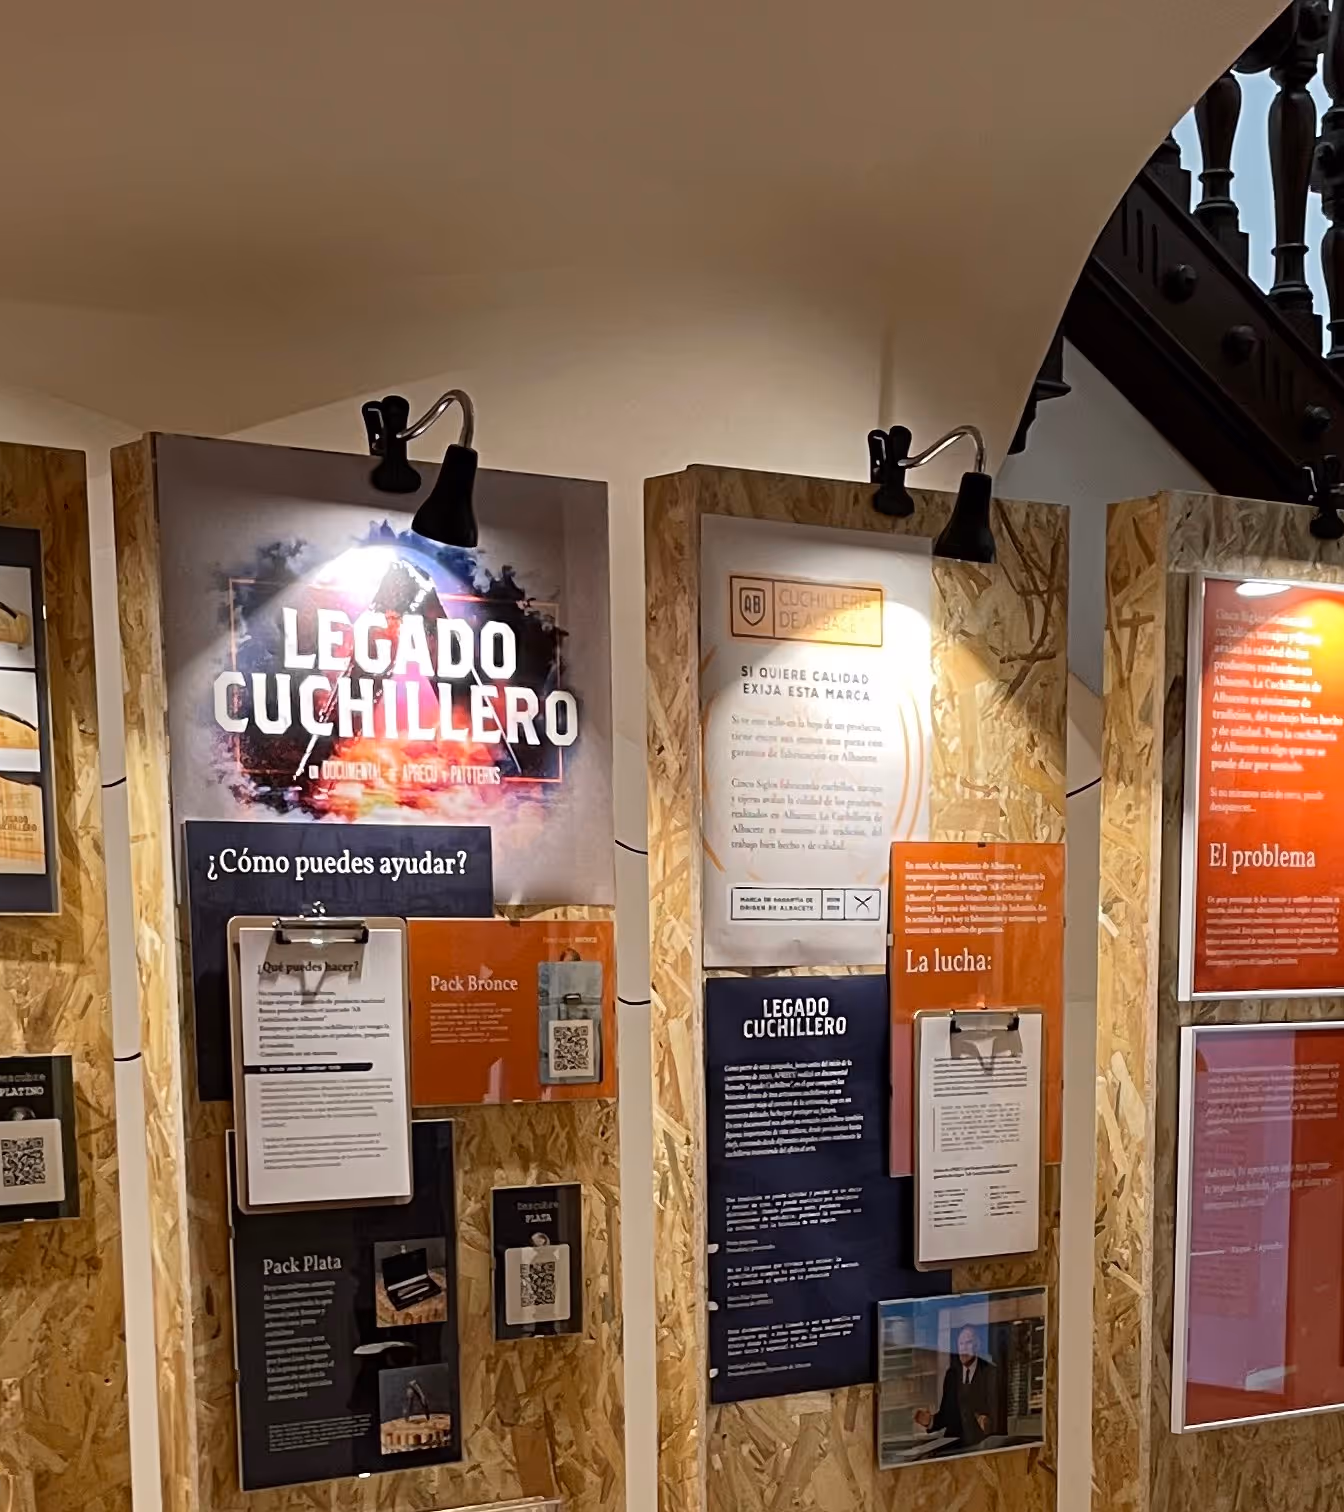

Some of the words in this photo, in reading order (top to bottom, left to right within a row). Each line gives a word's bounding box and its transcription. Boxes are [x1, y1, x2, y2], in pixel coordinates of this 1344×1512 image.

[282, 607, 517, 680] LEGADO
[741, 666, 753, 677] SI
[759, 667, 806, 681] QUIERE
[813, 671, 869, 684] CALIDAD
[743, 683, 781, 696] EXIJA
[789, 686, 819, 699] ESTA
[825, 688, 870, 701] MARCA
[213, 670, 579, 748] CUCHILLERO
[207, 847, 290, 881] ¿Cómo
[295, 850, 374, 880] puedes
[380, 850, 467, 879] ayudar?
[1209, 843, 1228, 867] El
[1232, 843, 1316, 874] problema
[286, 962, 322, 974] puedes
[325, 961, 359, 972] hacer?
[906, 949, 928, 973] La
[934, 947, 992, 972] lucha:
[430, 975, 465, 993] Pack
[468, 975, 518, 993] Bronce
[763, 997, 829, 1018] LEGADO
[743, 1016, 847, 1039] CUCHILLERO
[0, 1087, 44, 1097] PLATINO
[263, 1257, 300, 1275] Pack
[304, 1255, 342, 1272] Plata
